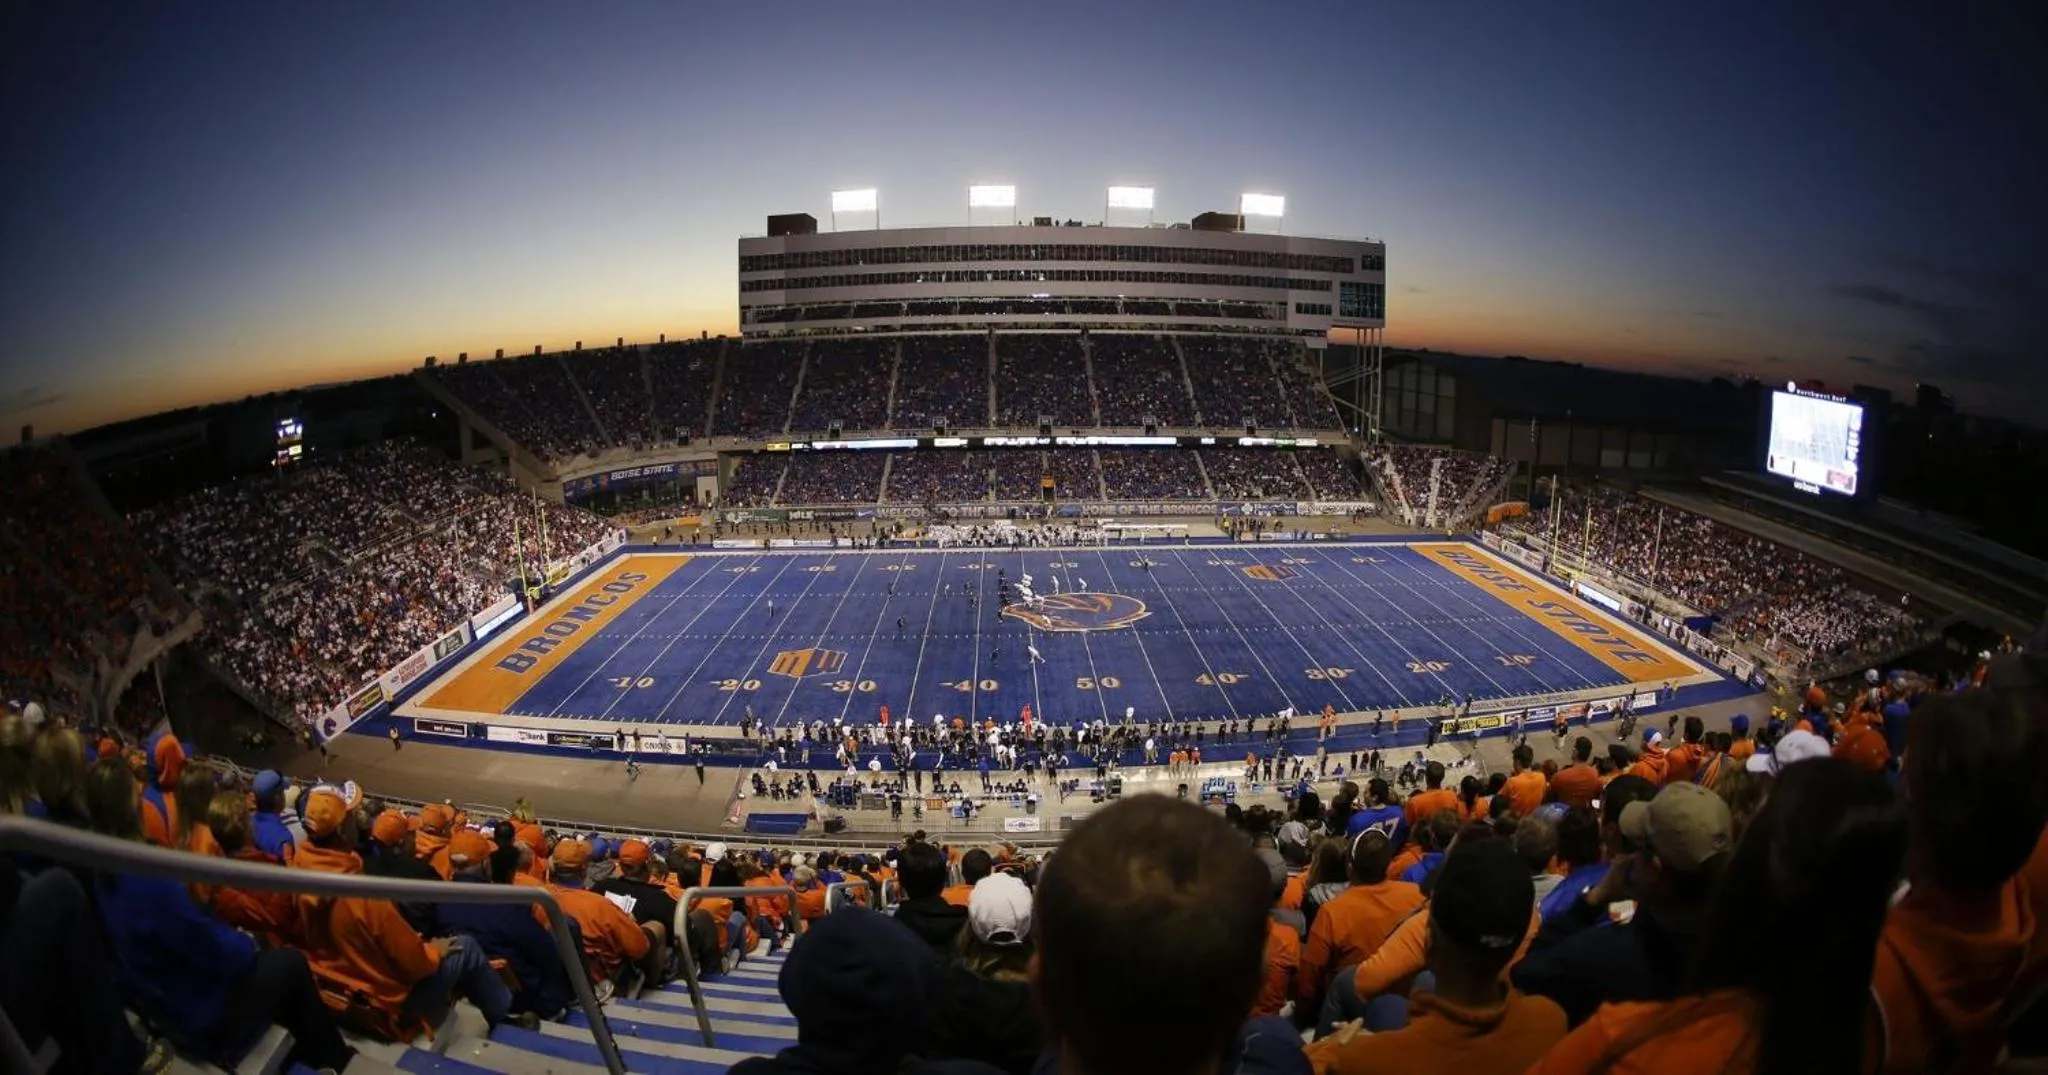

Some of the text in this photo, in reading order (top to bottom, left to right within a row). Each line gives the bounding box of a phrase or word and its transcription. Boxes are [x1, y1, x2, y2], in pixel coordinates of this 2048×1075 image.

[610, 464, 674, 480] BOISE STATE
[1082, 504, 1218, 515] HOME OF THE BRONCOS
[1435, 550, 1536, 593] BOISE
[1526, 600, 1663, 665] STATE
[492, 572, 648, 674] BRONCOS
[1496, 655, 1530, 666] 10
[1405, 661, 1443, 673] 20
[1195, 673, 1238, 685] 40
[1305, 667, 1347, 680] 30
[615, 677, 654, 688] 10
[719, 679, 761, 691] 20
[832, 680, 877, 692] 30
[954, 680, 999, 691] 40
[1076, 677, 1121, 689] 50
